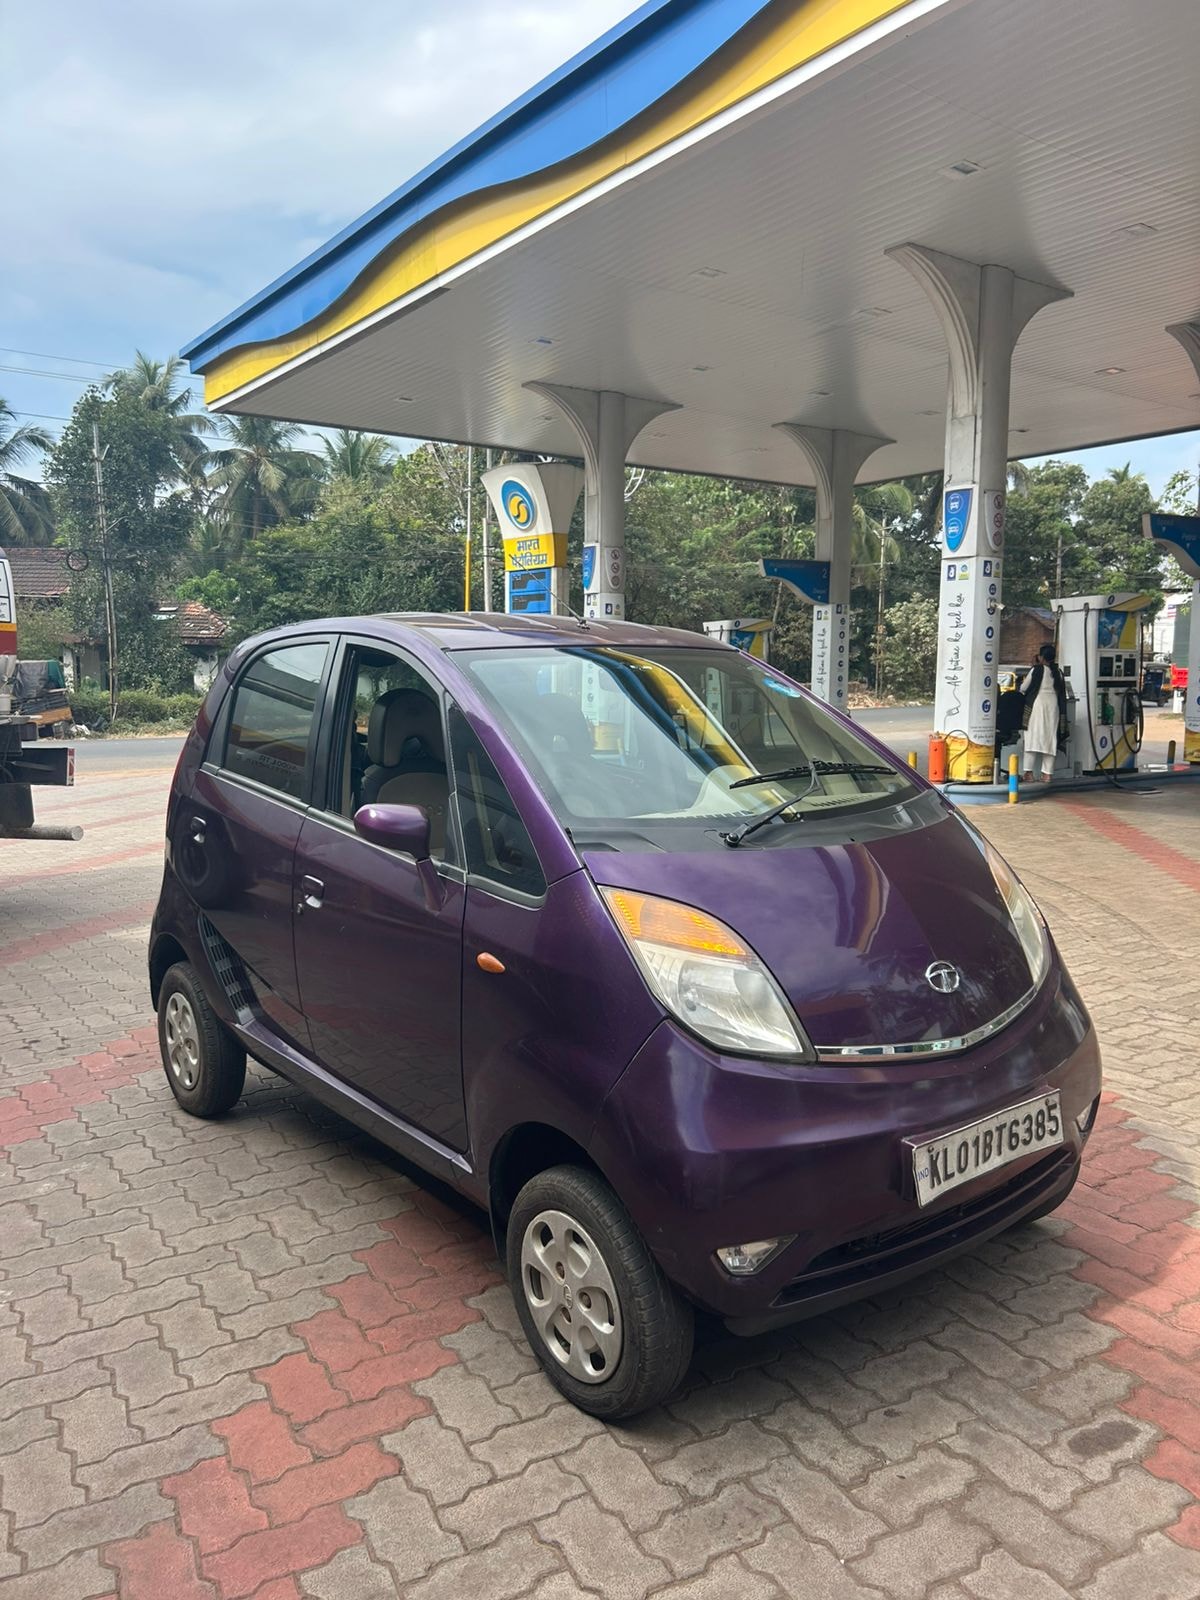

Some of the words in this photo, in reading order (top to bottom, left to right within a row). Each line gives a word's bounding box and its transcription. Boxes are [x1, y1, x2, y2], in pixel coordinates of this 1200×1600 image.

[517, 539, 539, 551] भारत
[929, 1102, 1059, 1188] KL01BT6385
[918, 1167, 929, 1181] IND
